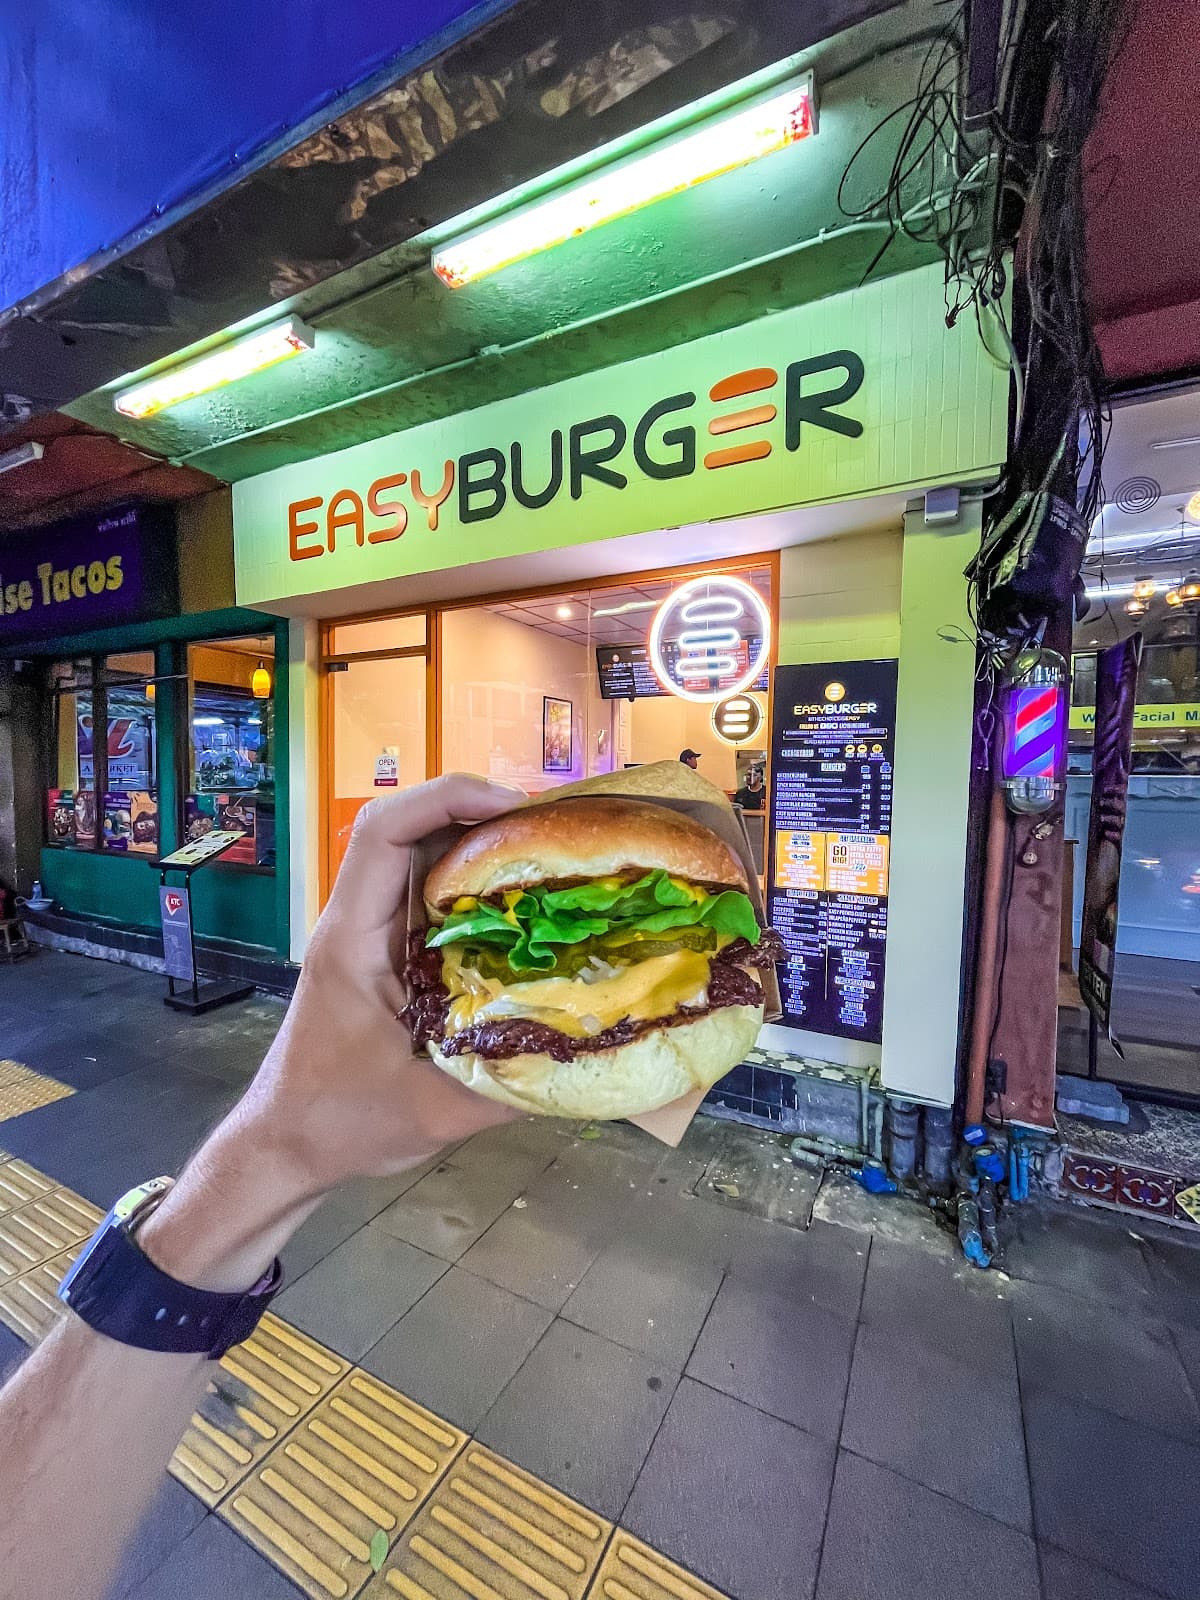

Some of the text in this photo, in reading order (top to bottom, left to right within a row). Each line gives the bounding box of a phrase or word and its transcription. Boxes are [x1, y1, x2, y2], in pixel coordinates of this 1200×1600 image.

[288, 349, 866, 562] EASYBURGER
[37, 555, 124, 606] Tacos
[793, 703, 877, 716] EASYBURGER
[378, 758, 396, 766] OPEN
[833, 845, 847, 856] GO
[832, 856, 847, 864] BIG!
[170, 897, 181, 906] KTC
